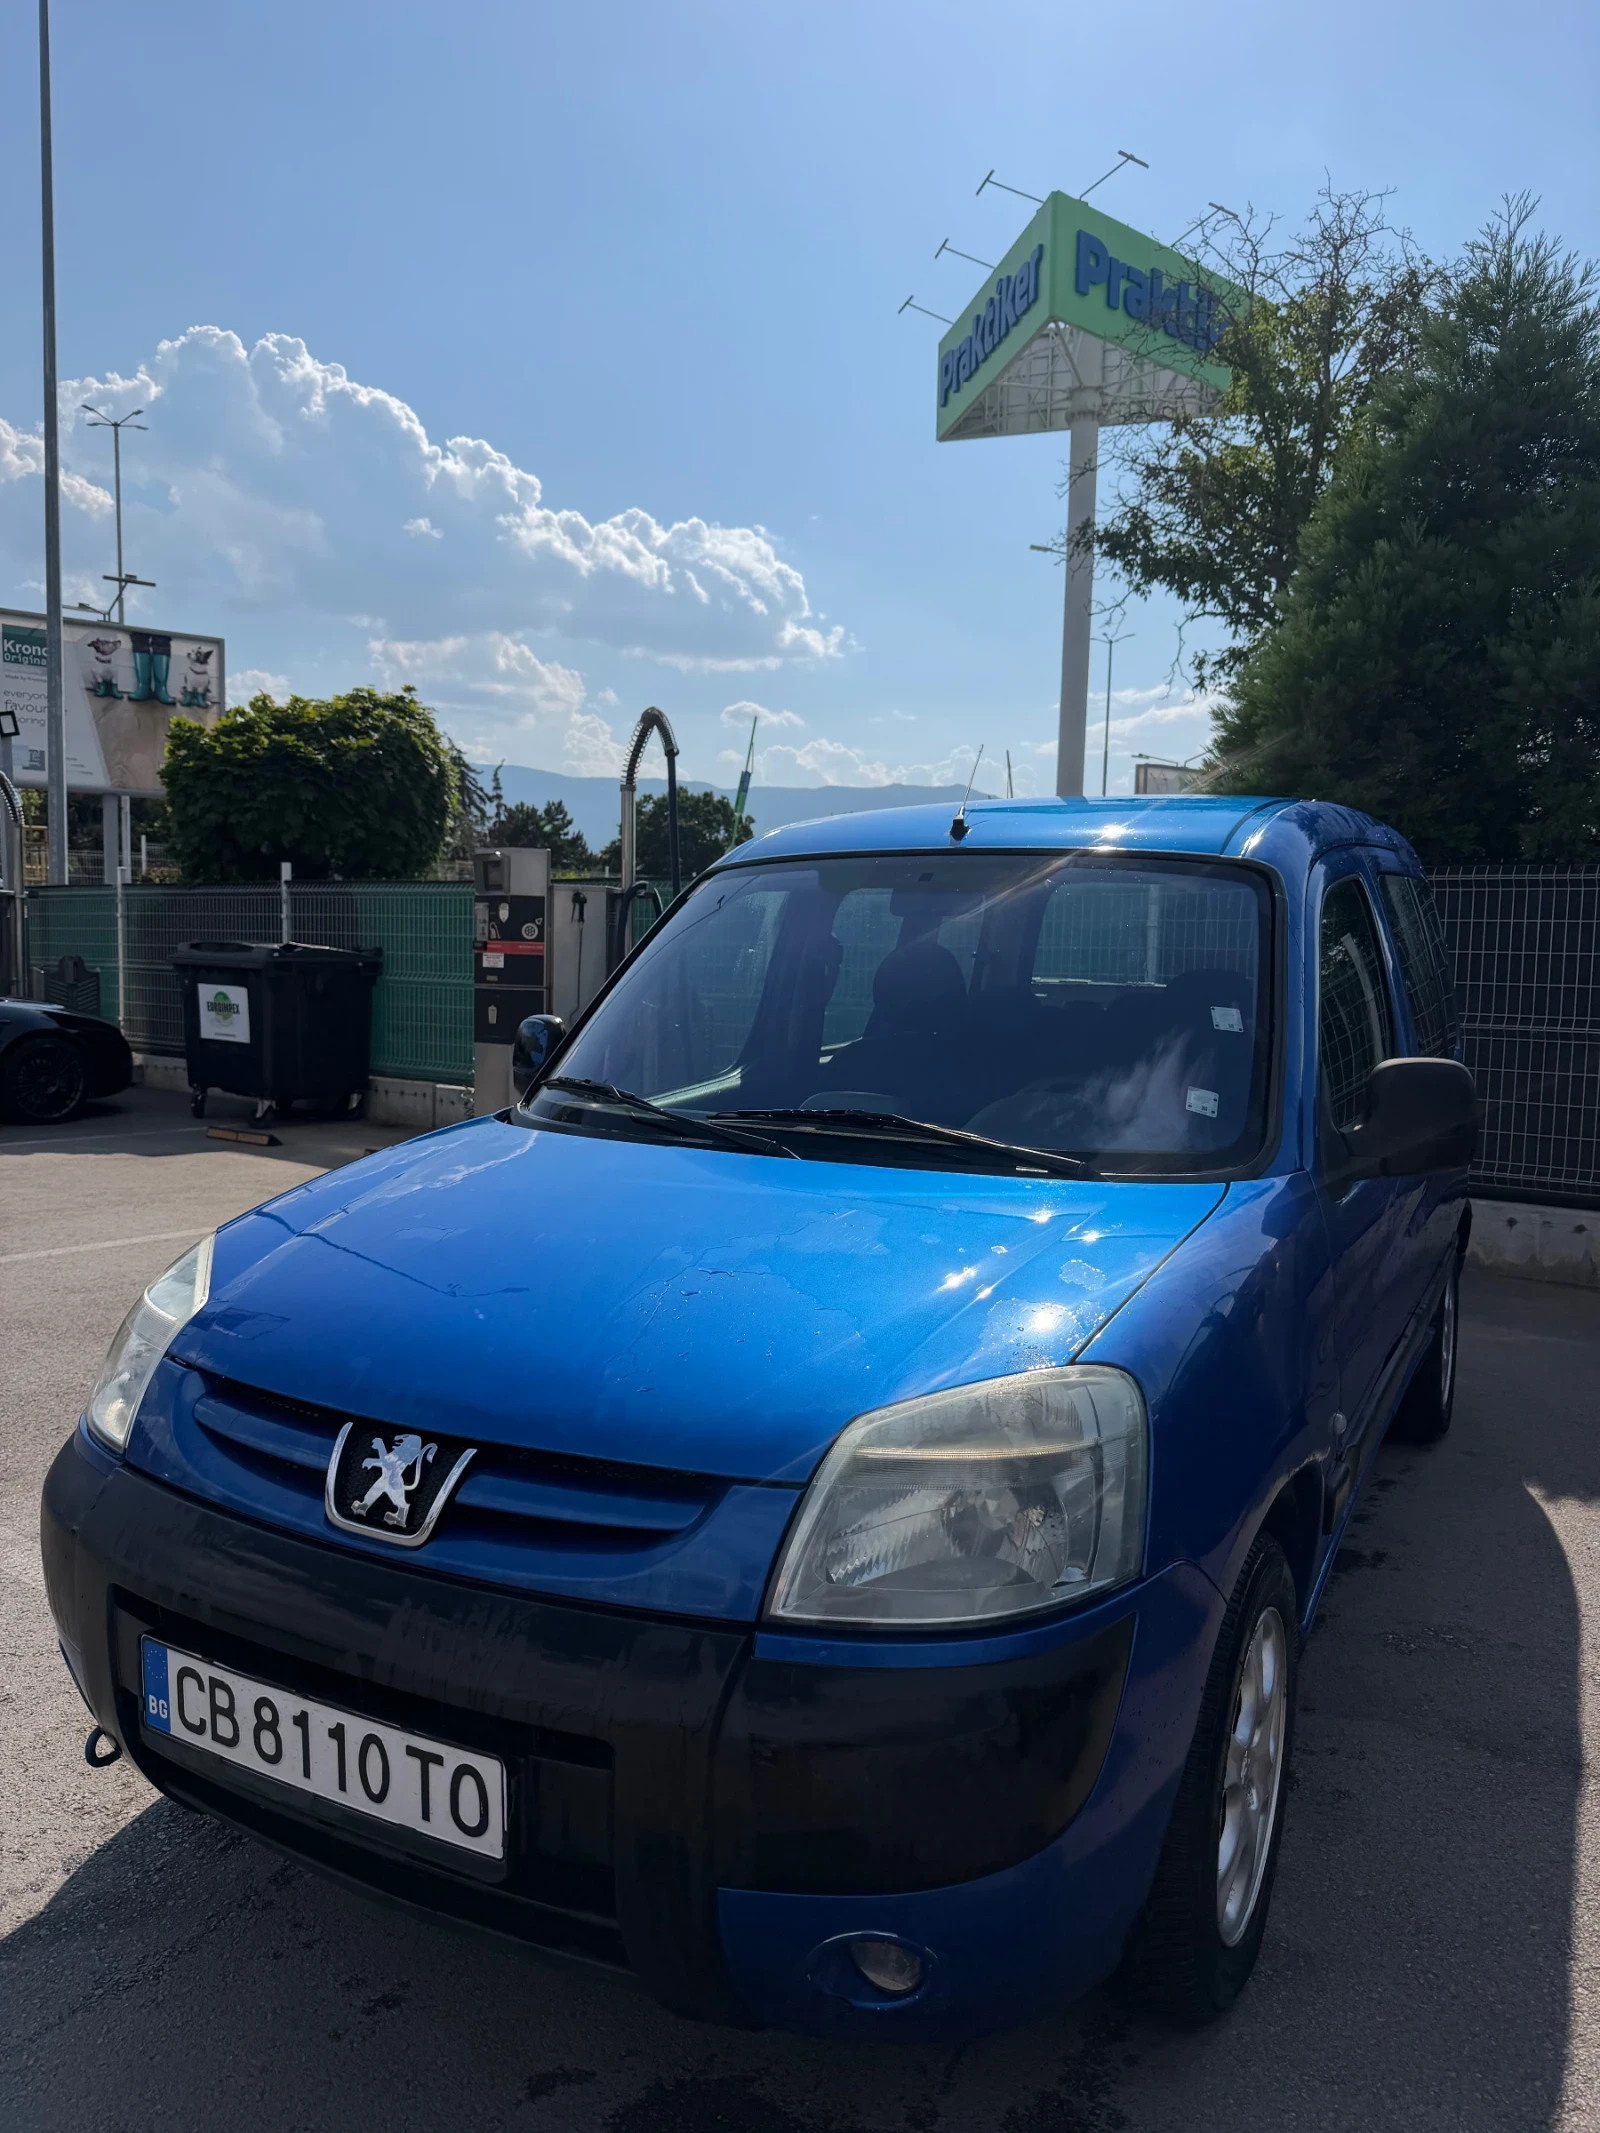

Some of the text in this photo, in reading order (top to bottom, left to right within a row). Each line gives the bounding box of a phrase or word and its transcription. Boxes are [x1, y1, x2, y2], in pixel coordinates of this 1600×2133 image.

[940, 243, 1044, 408] Praktiker
[4, 652, 48, 666] Origina
[4, 698, 49, 713] favour
[148, 1694, 169, 1719] BG
[176, 1665, 489, 1837] CB 8110 TO
